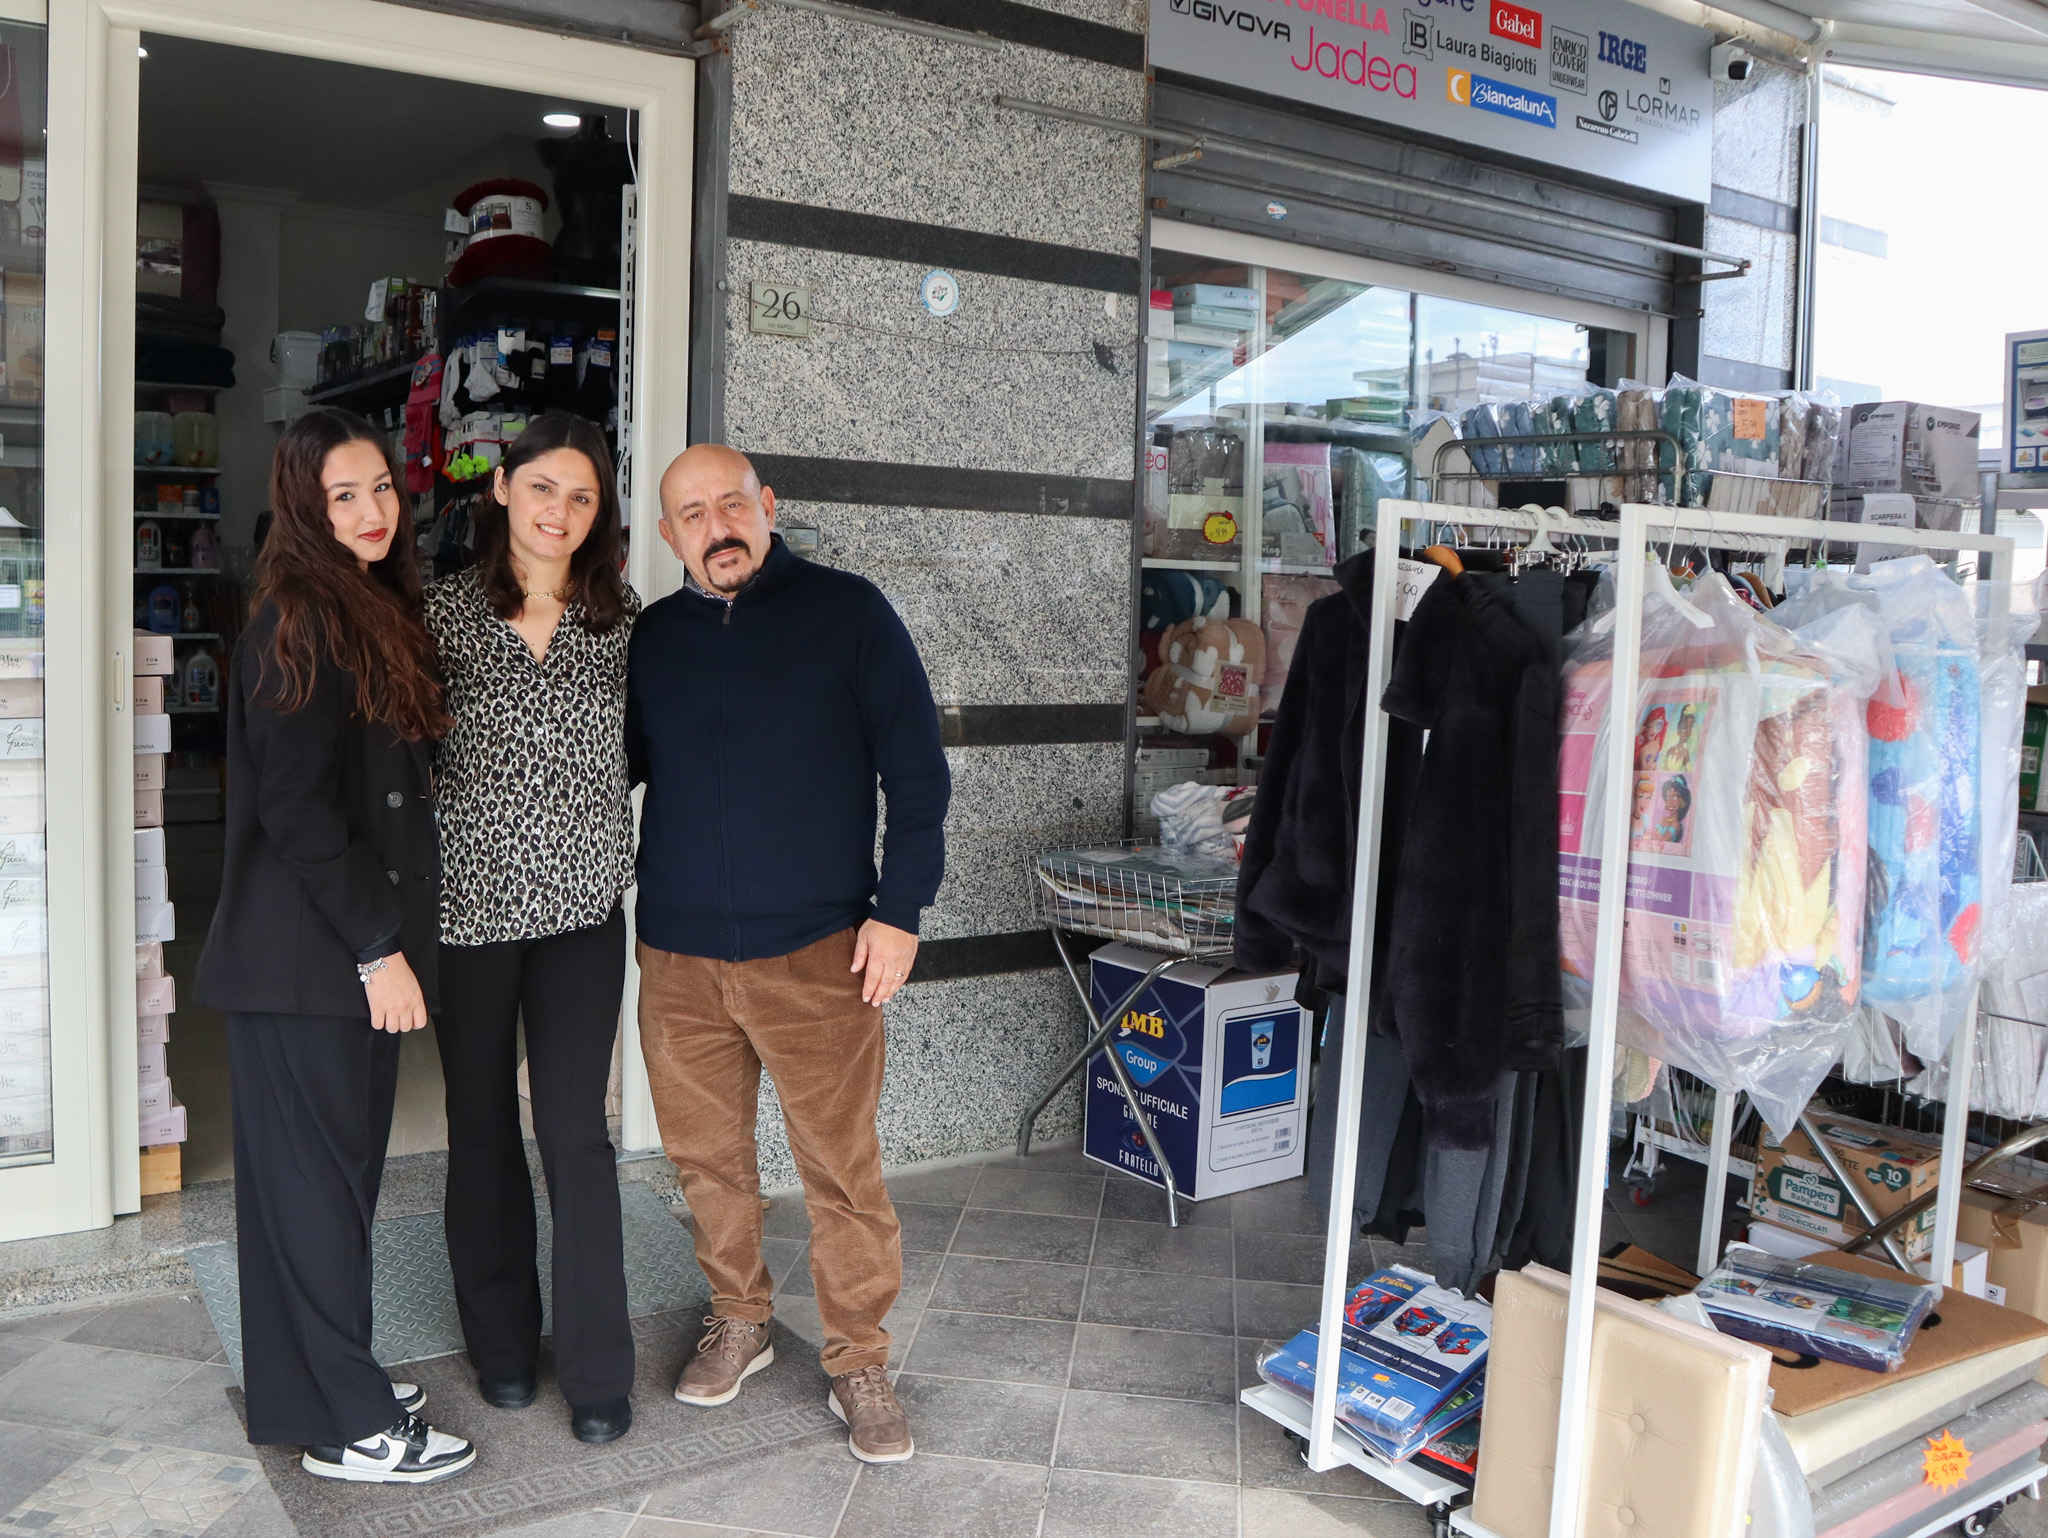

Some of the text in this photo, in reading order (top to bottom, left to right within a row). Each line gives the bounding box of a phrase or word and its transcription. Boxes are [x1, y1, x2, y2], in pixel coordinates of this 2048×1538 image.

[1192, 0, 1291, 42] GIVOVA
[1496, 9, 1535, 39] Gabel
[1436, 29, 1537, 76] Laura Biagiotti
[1553, 35, 1587, 60] ENRICO
[1598, 30, 1647, 74] IRGE
[1291, 25, 1417, 100] Jadea
[1552, 50, 1587, 74] COVERI
[1552, 70, 1585, 90] UNDERWEAR
[1626, 88, 1701, 129] LORMAR
[1635, 114, 1663, 129] BELLEZZA
[1578, 117, 1637, 143] Nazareno Gabrielli
[761, 288, 801, 320] 26
[1936, 420, 1961, 431] EMPORIO
[1126, 1050, 1157, 1074] Group
[1140, 1092, 1188, 1120] UFFICIALE
[1118, 1149, 1159, 1177] FRATELLO
[1886, 1168, 1903, 1183] 10
[1785, 1178, 1836, 1204] Pampers
[1790, 1191, 1828, 1211] Baby-dry
